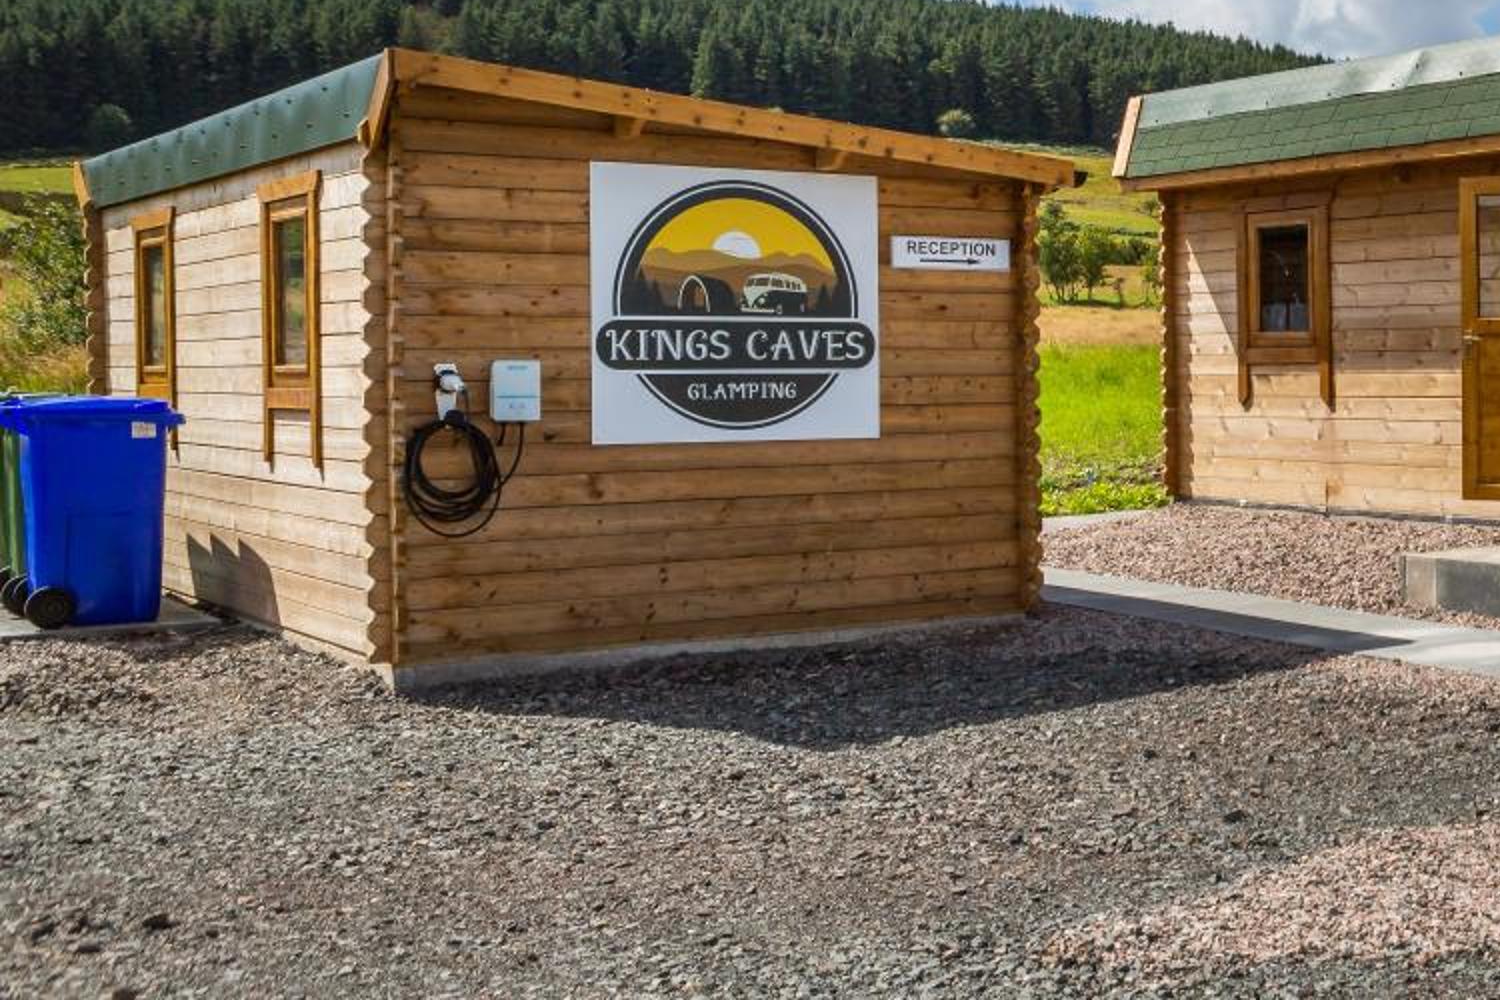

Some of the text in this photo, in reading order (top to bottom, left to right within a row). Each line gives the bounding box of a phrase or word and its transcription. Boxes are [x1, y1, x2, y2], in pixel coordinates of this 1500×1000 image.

[907, 240, 996, 257] RECEPTION
[605, 328, 866, 362] KINGS CAVES
[687, 381, 798, 401] GLAMPING
